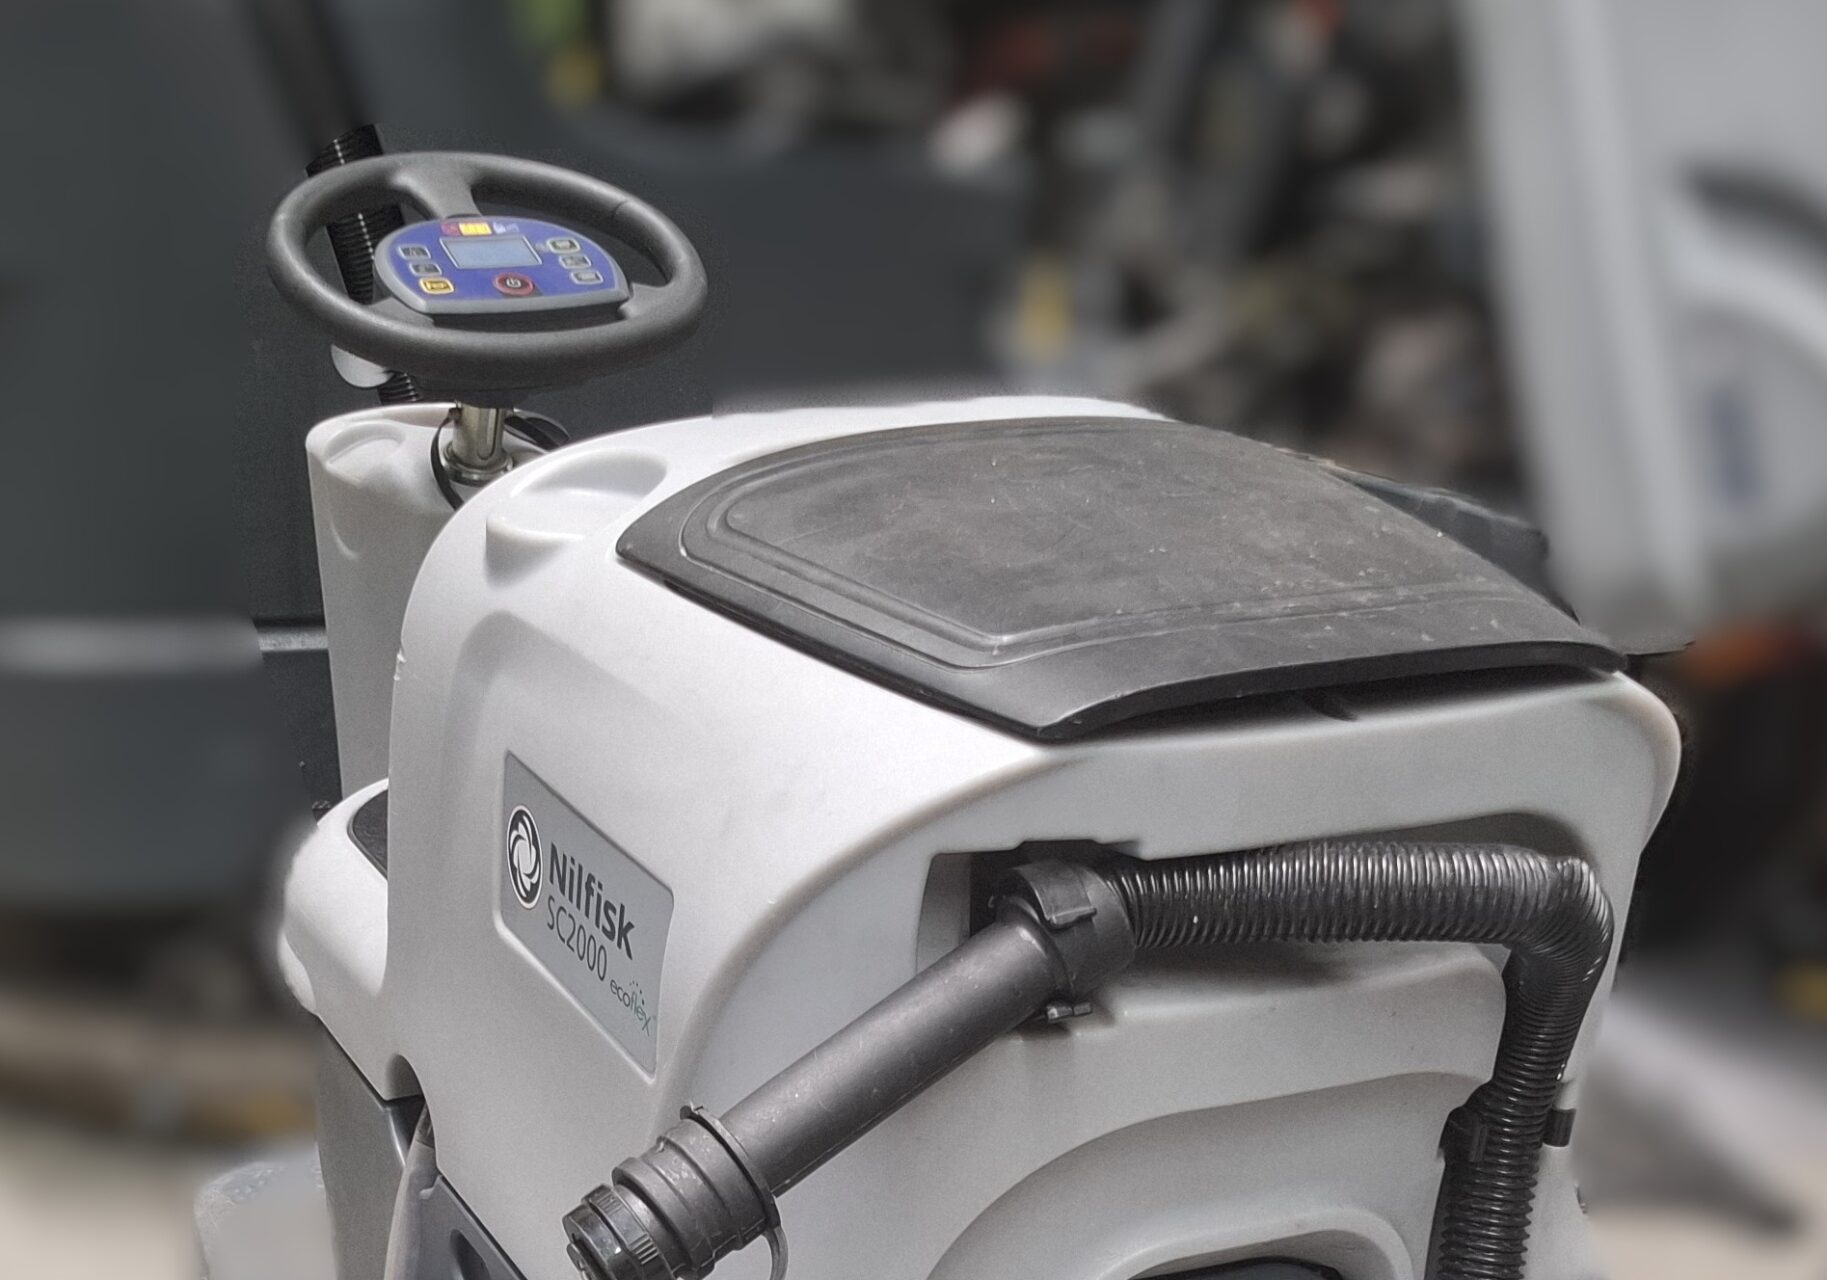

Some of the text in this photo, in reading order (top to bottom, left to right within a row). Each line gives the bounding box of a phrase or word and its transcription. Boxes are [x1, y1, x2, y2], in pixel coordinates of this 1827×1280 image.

[547, 895, 652, 1037] SC2000 ecoflex
[550, 842, 635, 961] Nilfisk
